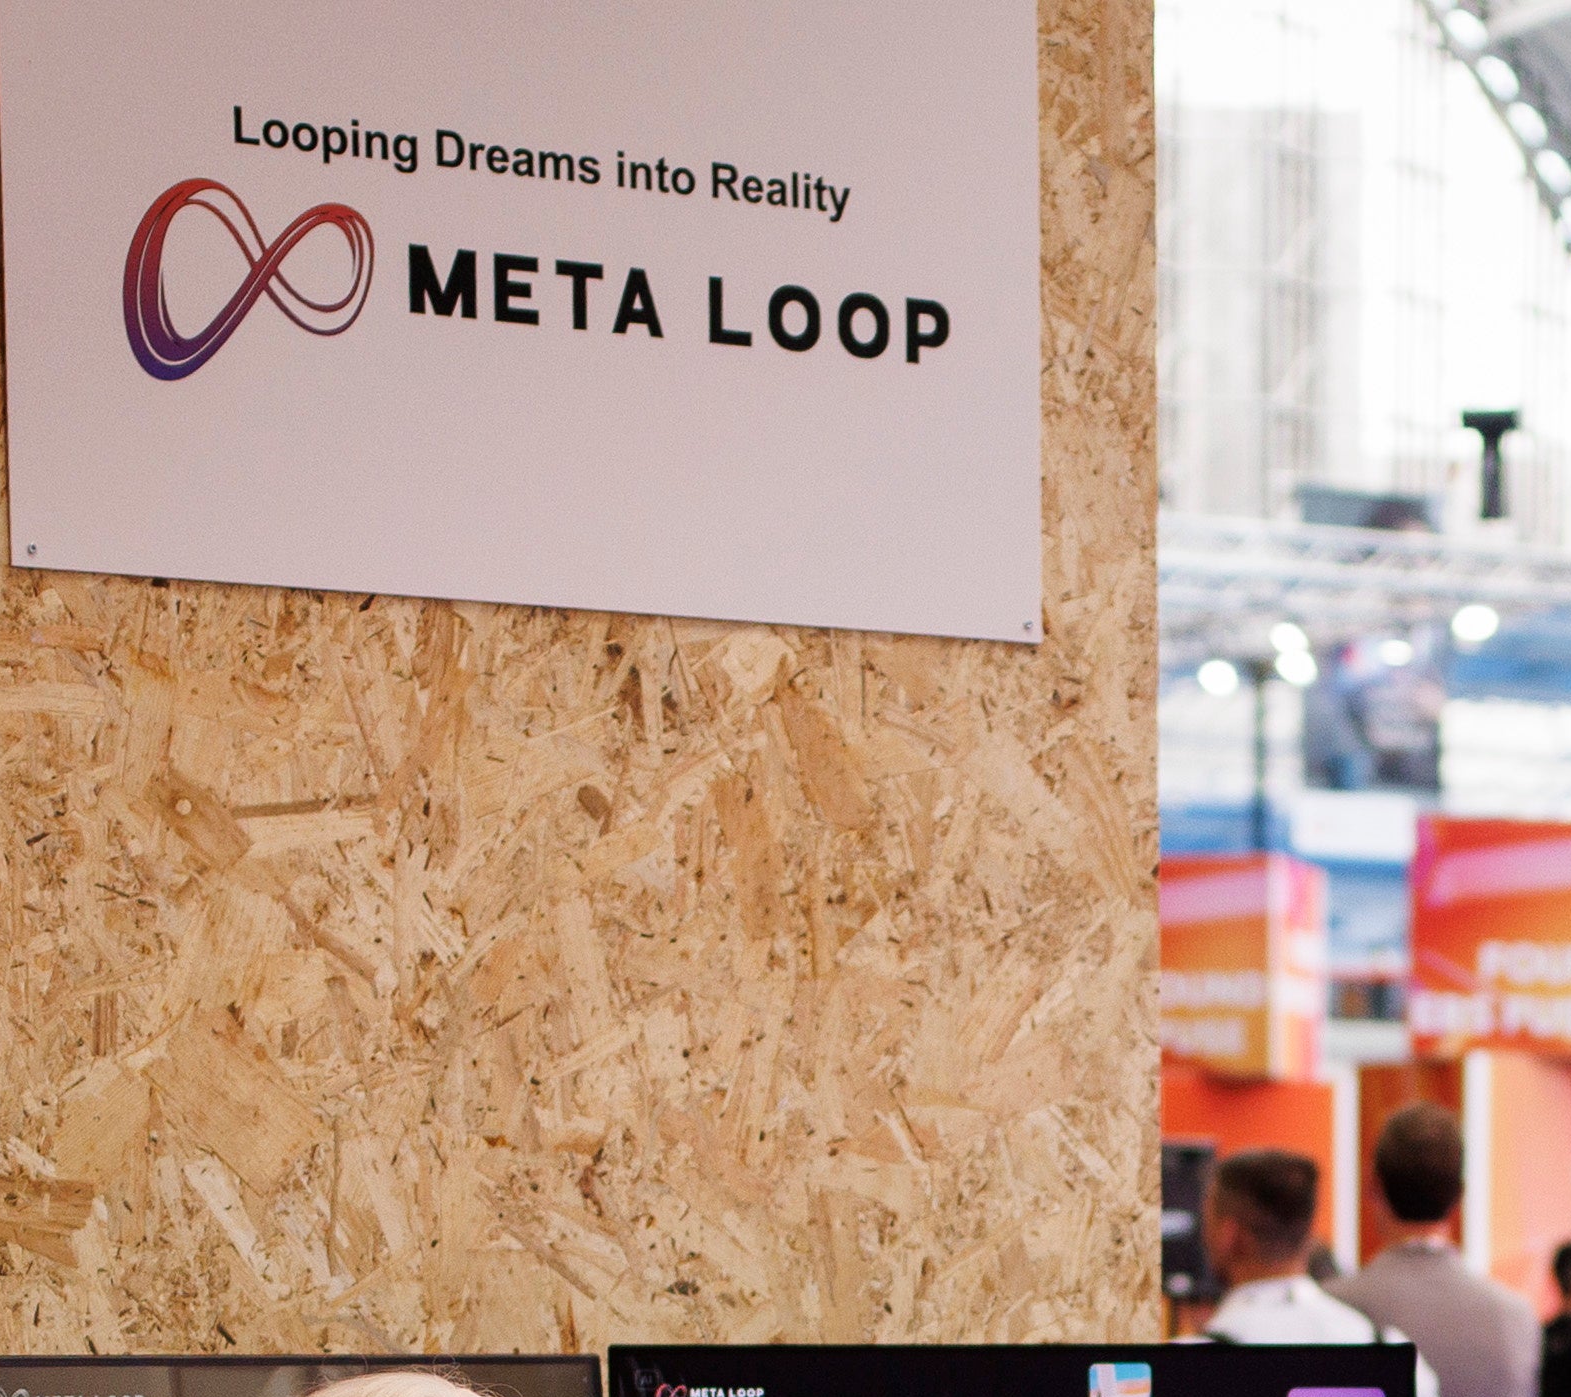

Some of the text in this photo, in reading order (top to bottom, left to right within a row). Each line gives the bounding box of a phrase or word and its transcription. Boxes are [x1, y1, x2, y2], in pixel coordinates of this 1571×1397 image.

[232, 105, 849, 222] Looping Dreams into Reality
[409, 244, 949, 363] META LOOP
